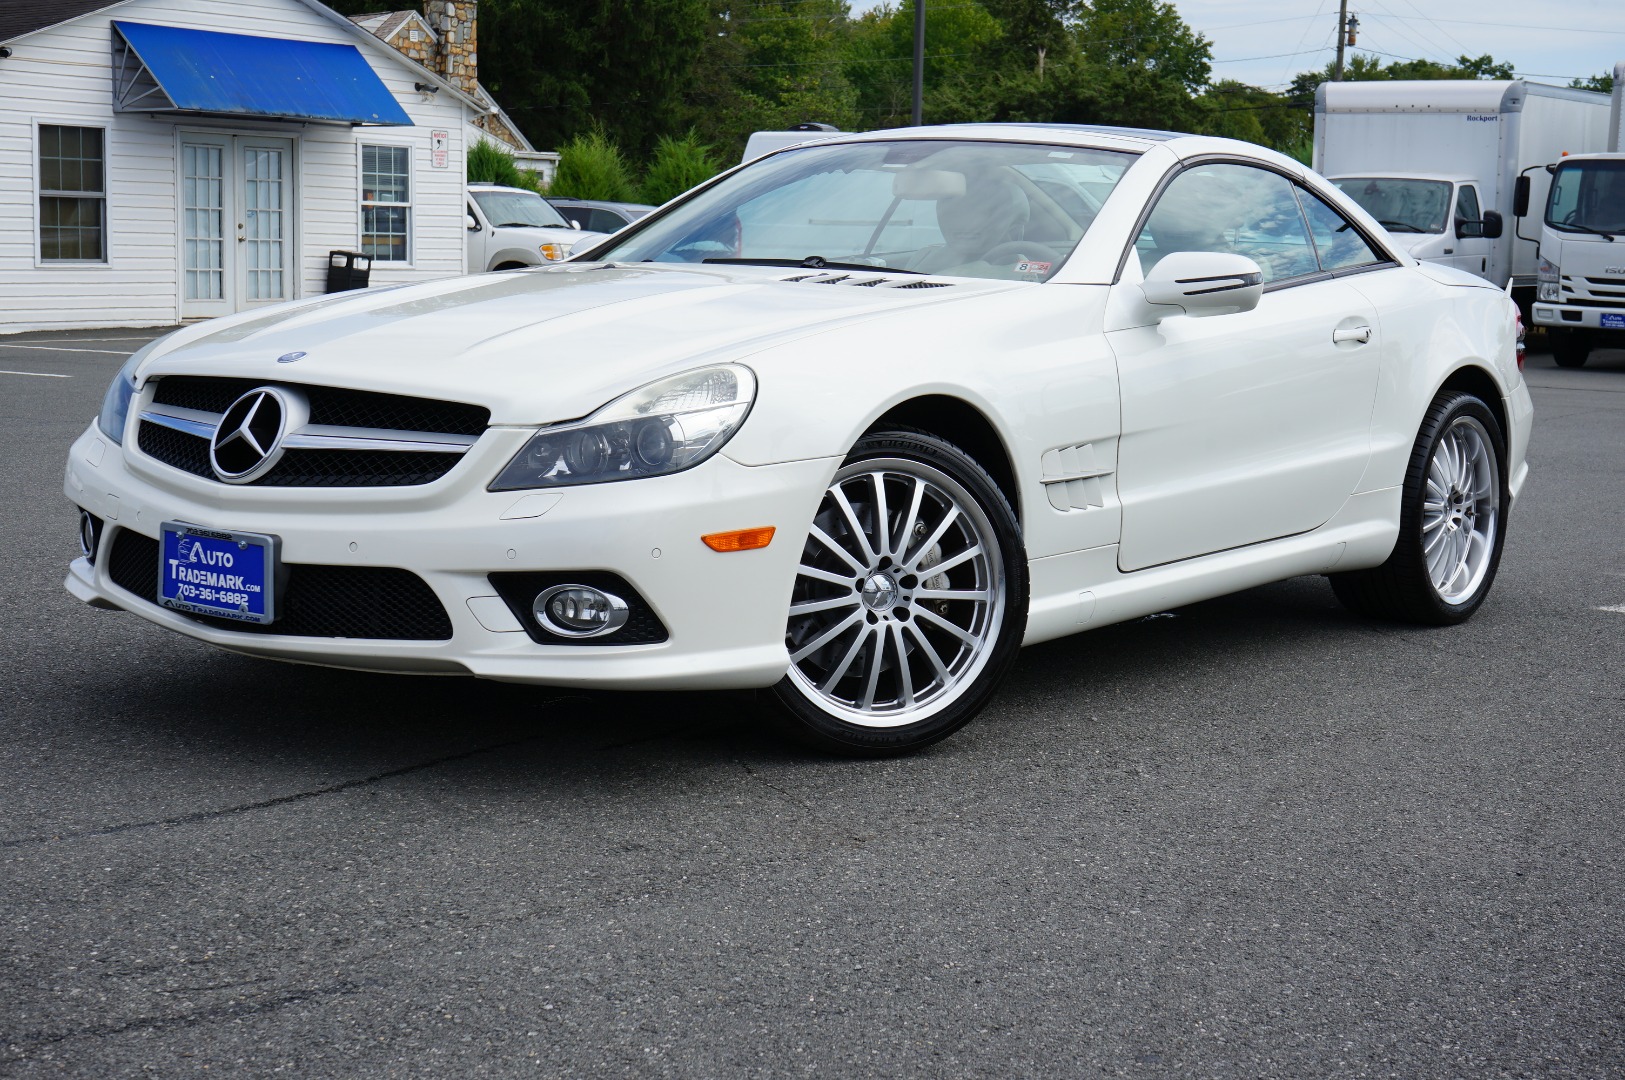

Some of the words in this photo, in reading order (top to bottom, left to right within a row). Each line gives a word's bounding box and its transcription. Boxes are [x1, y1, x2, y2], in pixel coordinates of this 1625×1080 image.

[1019, 263, 1028, 271] 8
[881, 440, 938, 456] MICHELIN
[189, 541, 234, 568] AUTO
[177, 583, 249, 606] 703-361-6882
